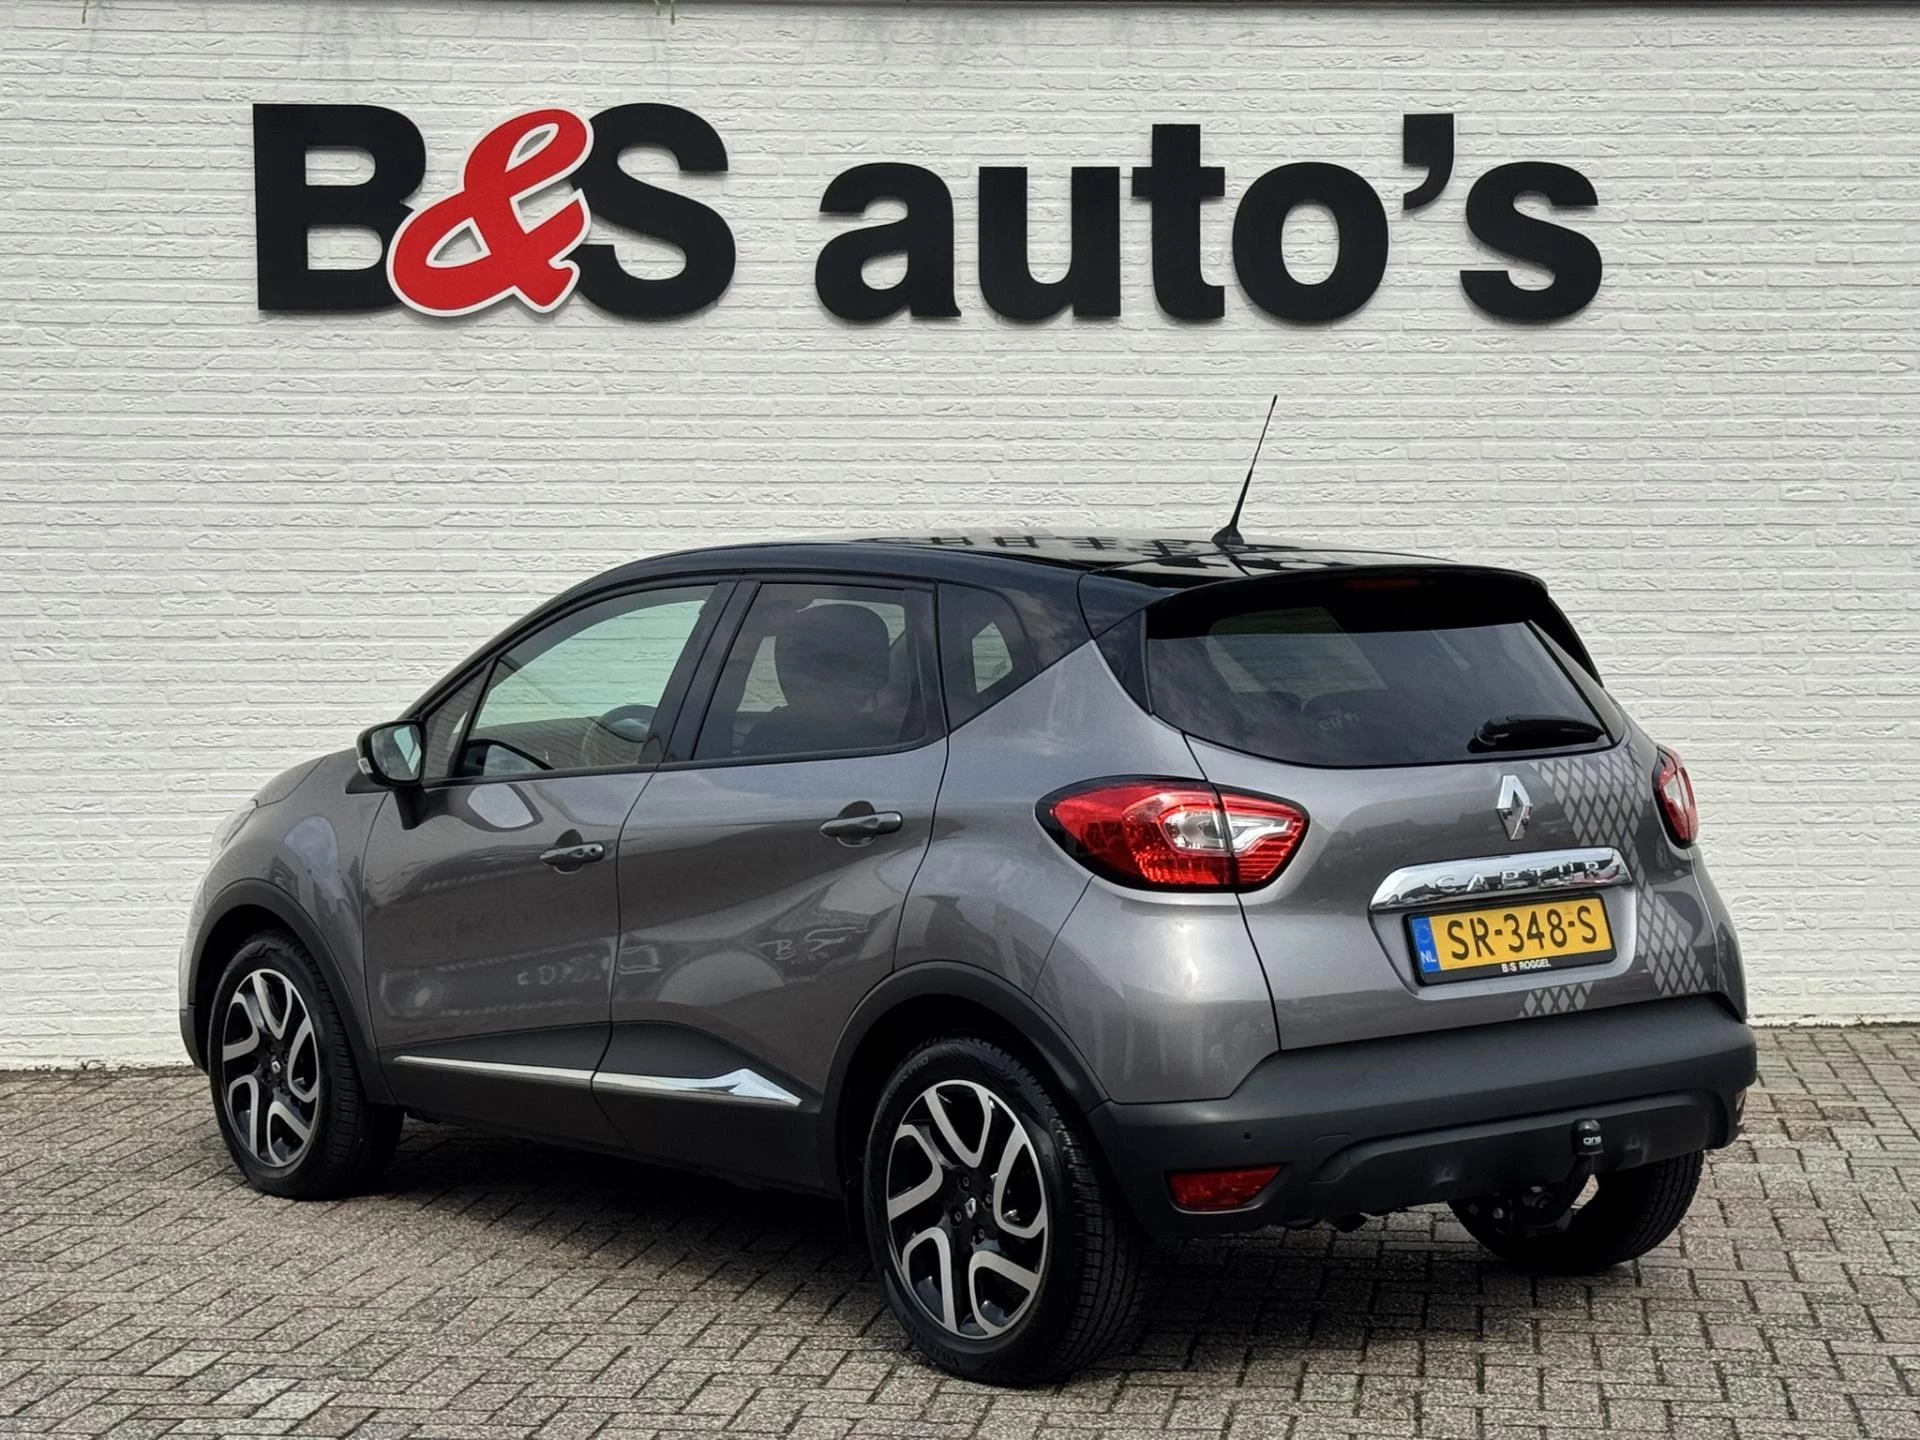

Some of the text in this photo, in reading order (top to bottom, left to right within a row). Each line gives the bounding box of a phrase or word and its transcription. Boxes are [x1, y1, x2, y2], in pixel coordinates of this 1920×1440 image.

[253, 103, 1602, 322] B&S auto's
[1447, 906, 1597, 960] SR-348-S
[1420, 950, 1437, 963] NL
[1519, 958, 1552, 971] ROGGEL
